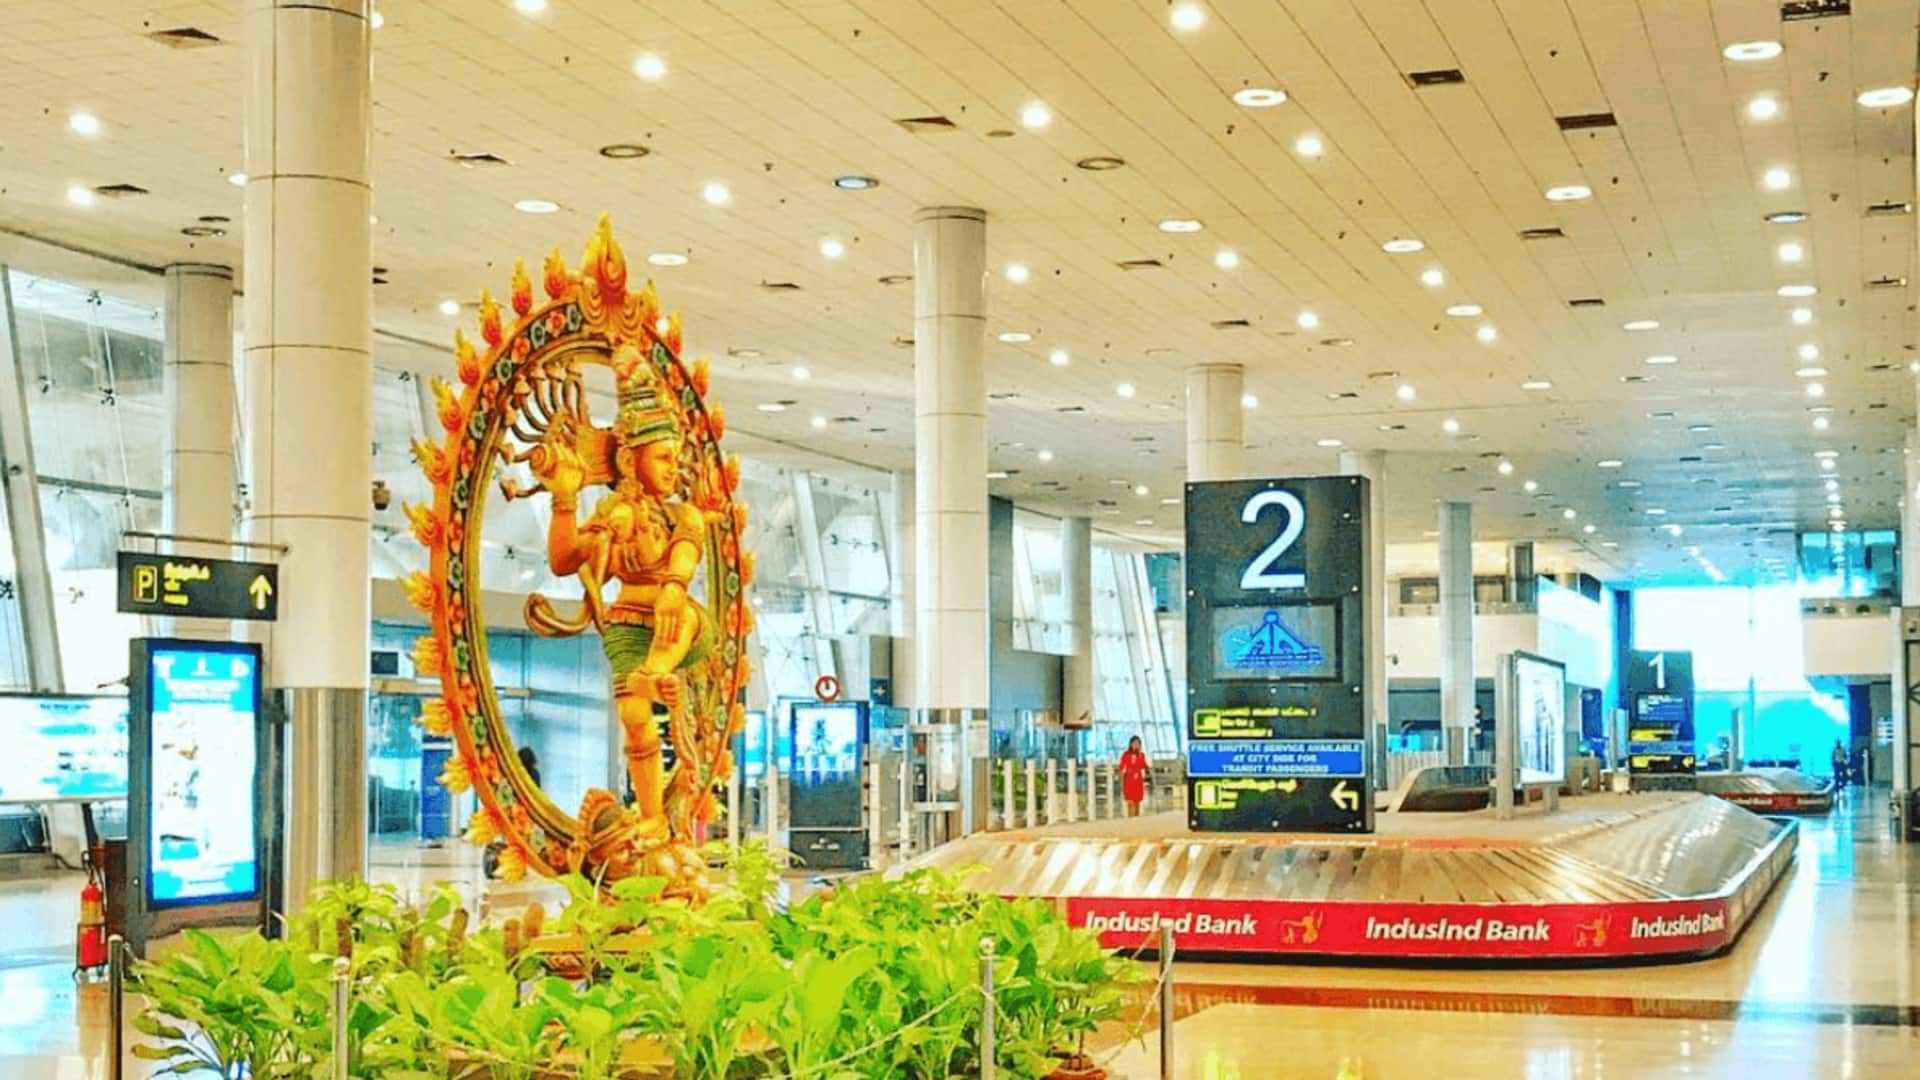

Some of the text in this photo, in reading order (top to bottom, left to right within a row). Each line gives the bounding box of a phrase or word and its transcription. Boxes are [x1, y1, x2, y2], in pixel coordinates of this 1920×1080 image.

[1240, 490, 1306, 589] 2
[138, 570, 153, 599] P
[1648, 652, 1666, 689] 1
[1191, 743, 1360, 753] FREE SHUTTLE SERVICE AVAILABLE
[1232, 754, 1246, 763] AT
[1247, 754, 1270, 763] CITY
[1297, 754, 1318, 763] FOR
[1221, 764, 1263, 773] TRANSIT
[1195, 913, 1258, 935] Bank
[1365, 916, 1551, 941] IndusInd Bank
[1630, 912, 1702, 938] IndusInd
